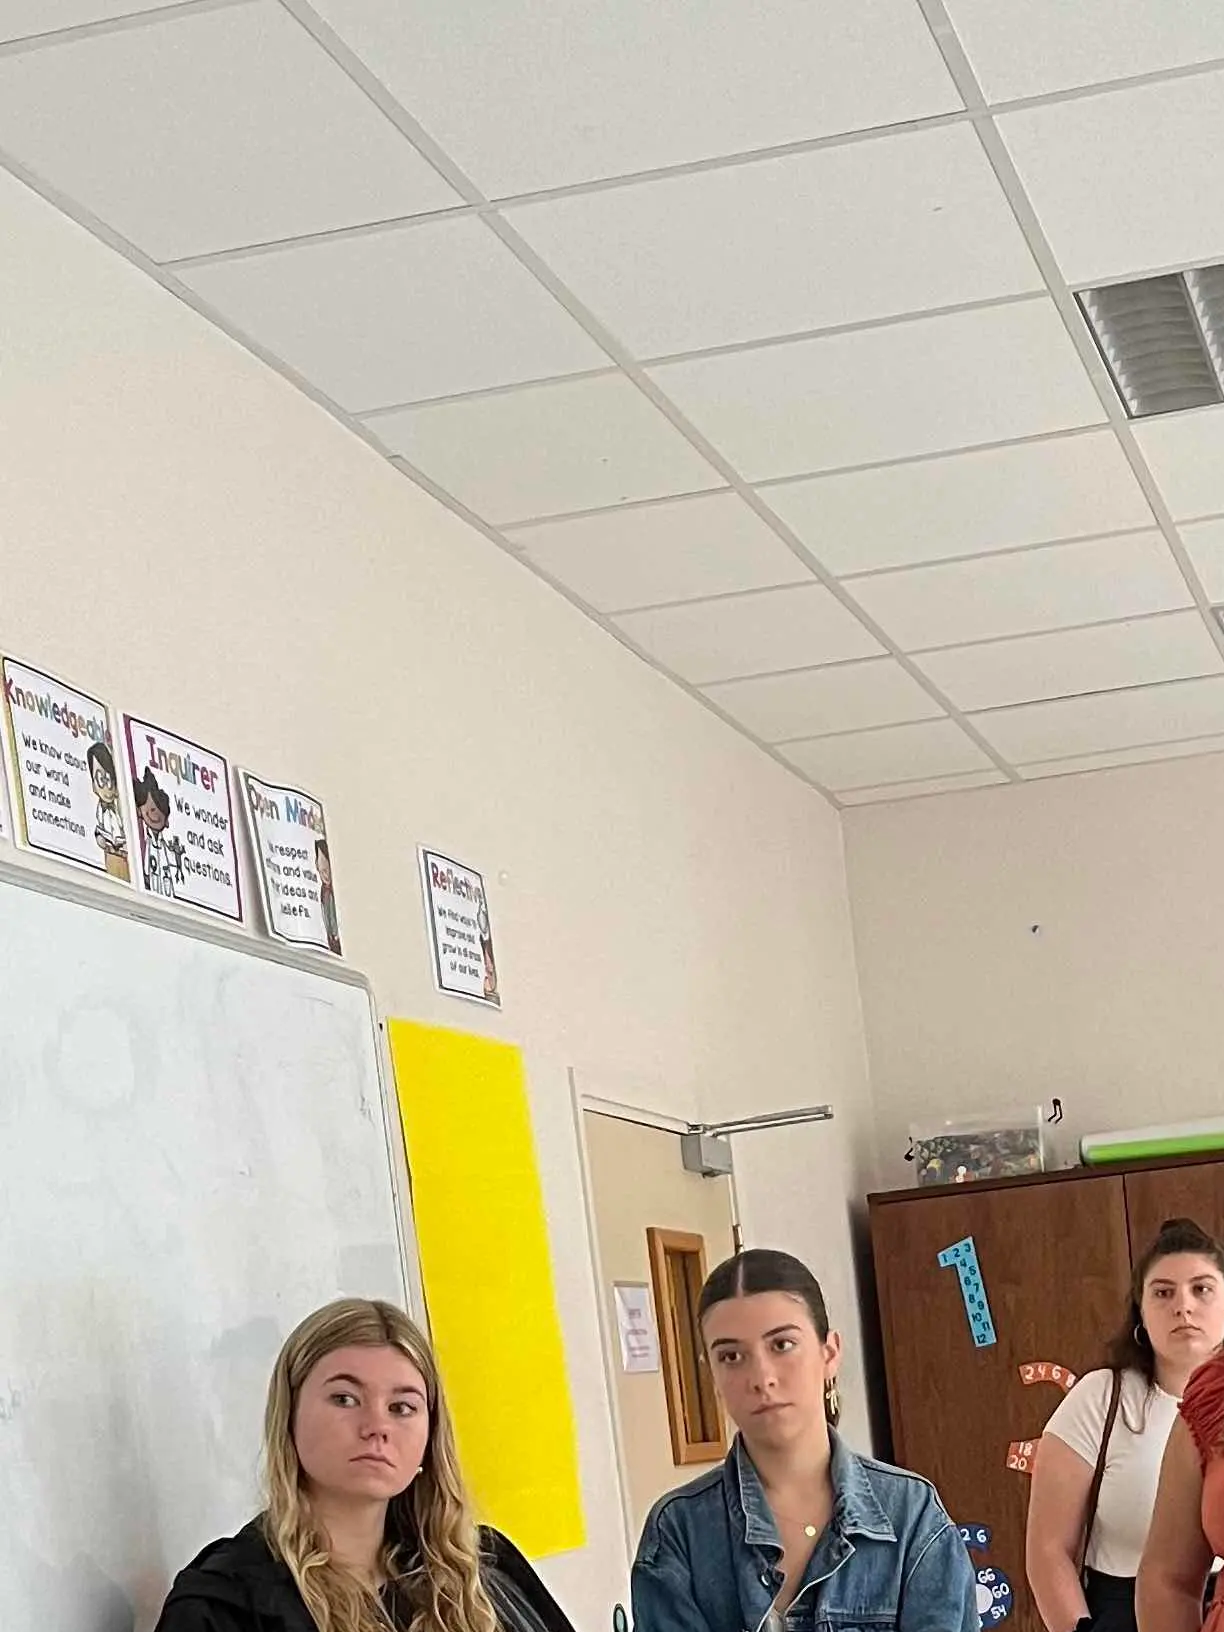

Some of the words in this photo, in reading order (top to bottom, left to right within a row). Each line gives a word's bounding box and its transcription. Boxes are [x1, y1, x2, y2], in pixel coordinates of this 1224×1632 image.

[22, 732, 38, 751] We
[145, 735, 218, 794] Inquirer
[174, 795, 191, 816] We
[192, 805, 229, 831] wonder
[187, 830, 205, 850] and
[207, 838, 224, 857] ask
[964, 1243, 971, 1252] 3
[953, 1248, 960, 1258] 2
[942, 1254, 948, 1263] 1
[960, 1258, 967, 1267] 4
[969, 1266, 976, 1275] 5
[964, 1276, 971, 1286] 6
[973, 1283, 979, 1293] 7
[968, 1294, 975, 1304] 8
[977, 1301, 984, 1310] 9
[972, 1313, 982, 1322] 10
[982, 1322, 990, 1331] 11
[977, 1334, 986, 1344] 12
[1024, 1366, 1034, 1380] 2
[1038, 1364, 1046, 1377] 4
[1052, 1365, 1061, 1380] 6
[1019, 1441, 1033, 1456] 18
[1009, 1454, 1028, 1470] 20
[976, 1529, 987, 1543] 6
[978, 1568, 996, 1584] 66
[991, 1583, 1010, 1599] 60
[990, 1604, 1007, 1620] 54
